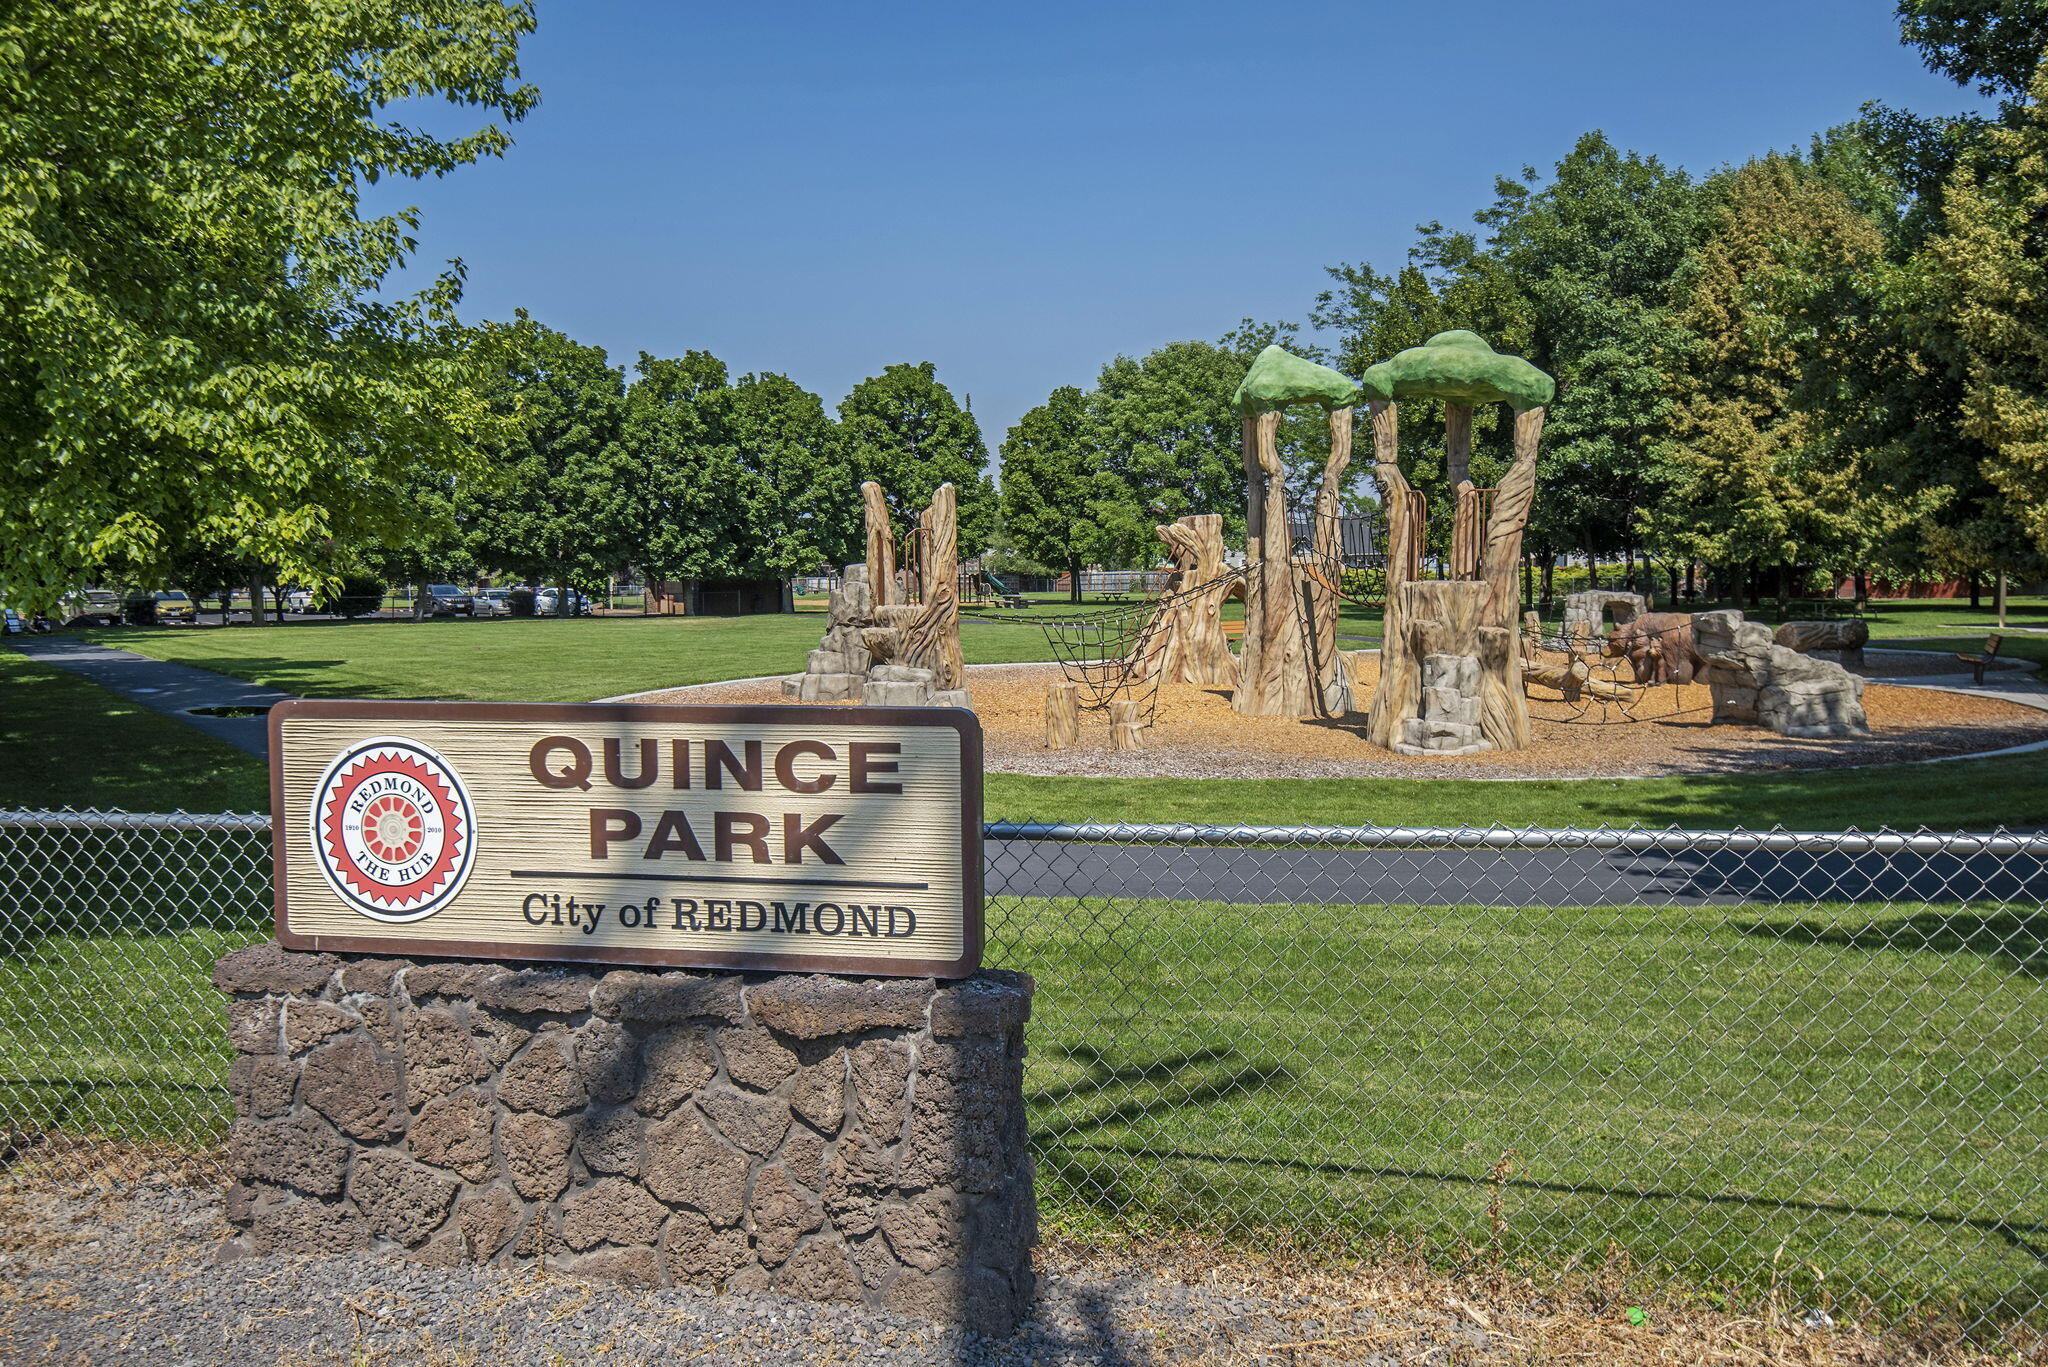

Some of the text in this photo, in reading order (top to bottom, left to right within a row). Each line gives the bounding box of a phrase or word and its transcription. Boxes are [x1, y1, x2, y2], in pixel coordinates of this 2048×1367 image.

[529, 735, 903, 795] QUINCE
[351, 777, 434, 814] REDMOND
[589, 808, 847, 866] PARK
[356, 851, 433, 882] THE HUB
[522, 892, 917, 938] City of REDMOND
